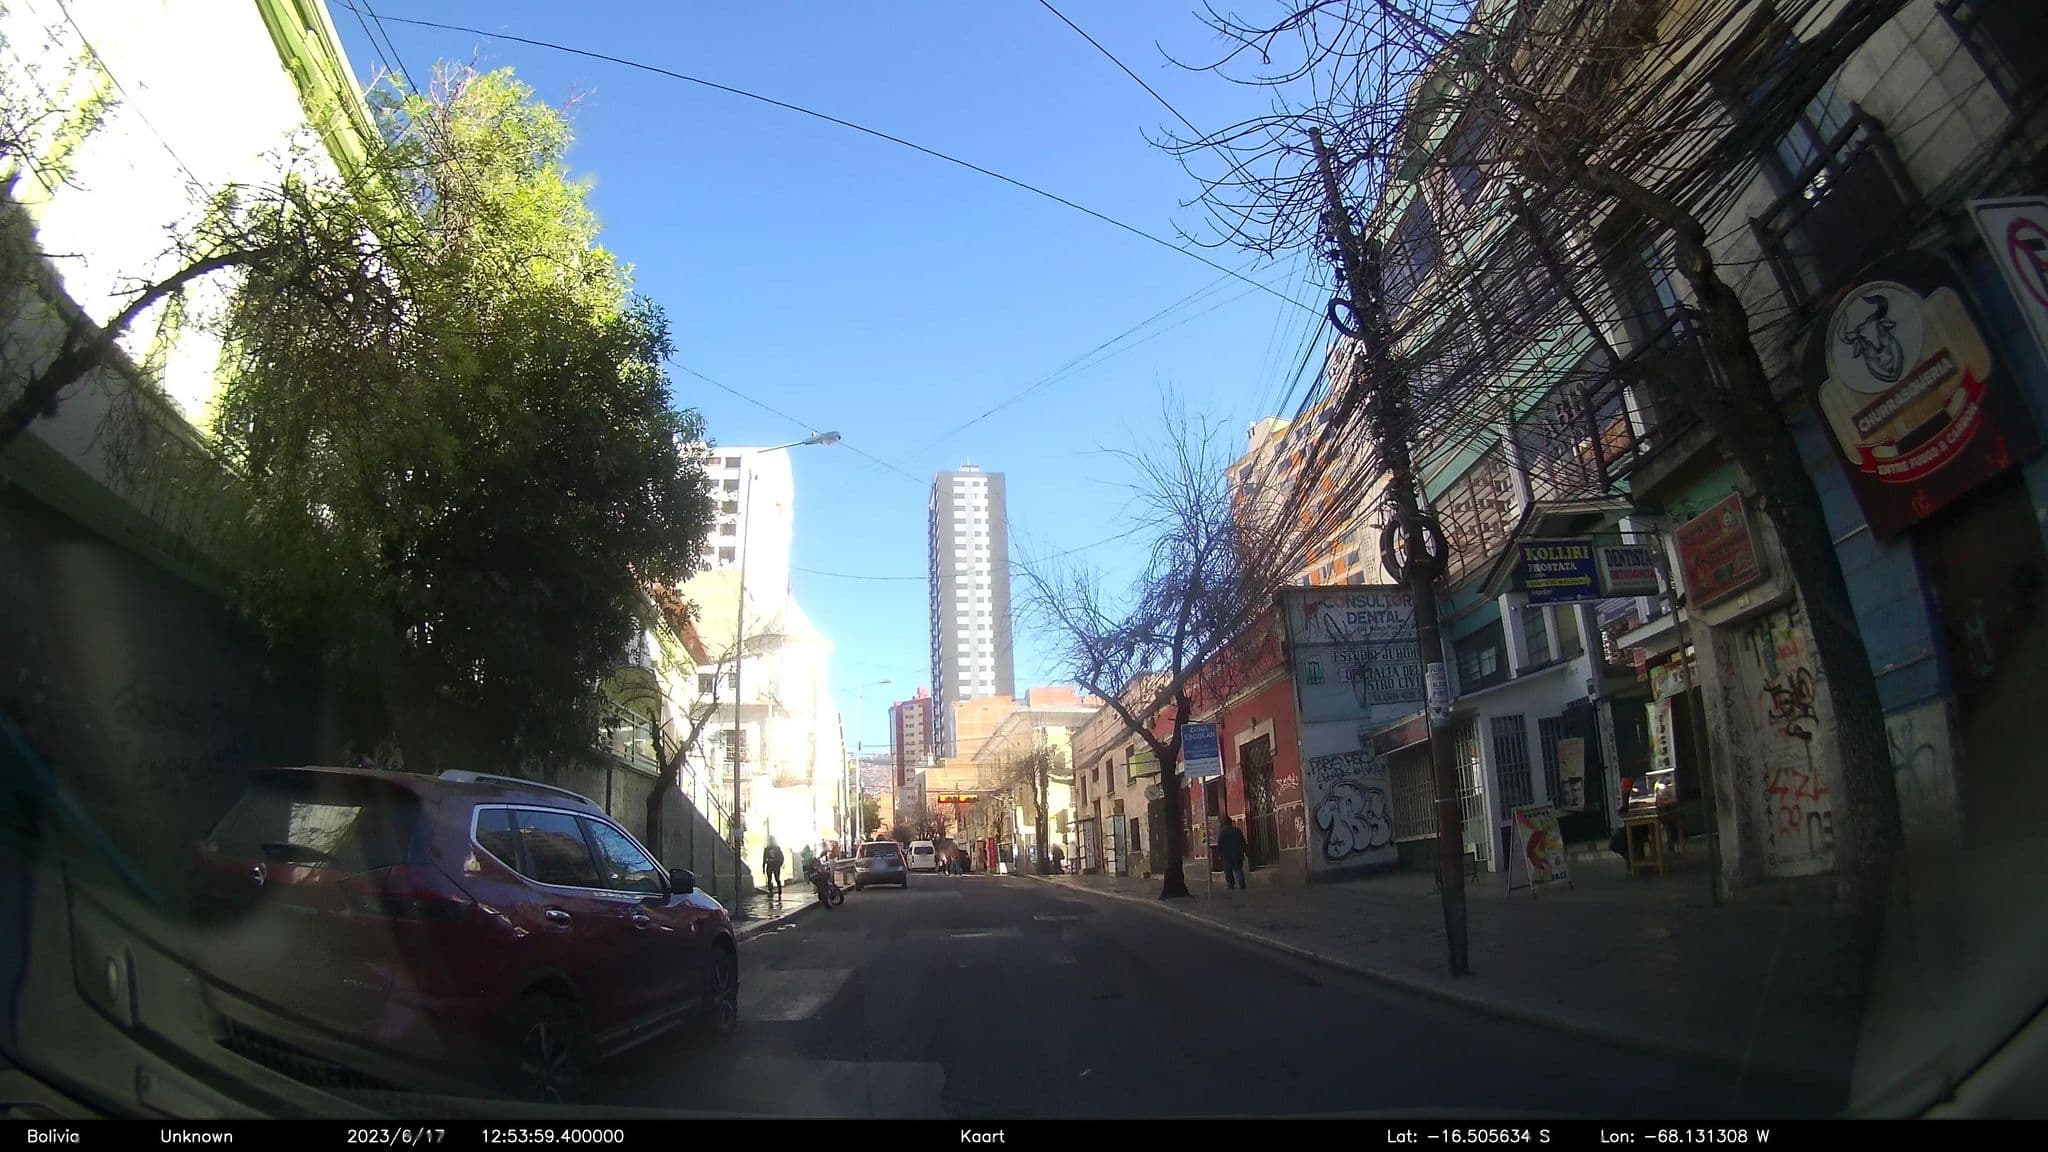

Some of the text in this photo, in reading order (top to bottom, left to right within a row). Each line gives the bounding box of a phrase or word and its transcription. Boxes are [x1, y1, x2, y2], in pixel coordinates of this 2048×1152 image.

[1859, 358, 1953, 432] CHURRASQUERIA
[1877, 461, 1909, 476] ENTRE
[1909, 447, 1938, 469] FUEGO
[1526, 546, 1590, 561] KOLLIRI
[1528, 562, 1577, 573] PROSTATA
[1323, 593, 1416, 610] CONSULTOR
[1346, 610, 1405, 625] DENTAL
[1382, 647, 1419, 660] JURIDI
[1398, 676, 1419, 689] CIVI
[1184, 733, 1216, 741] ESCOLAR
